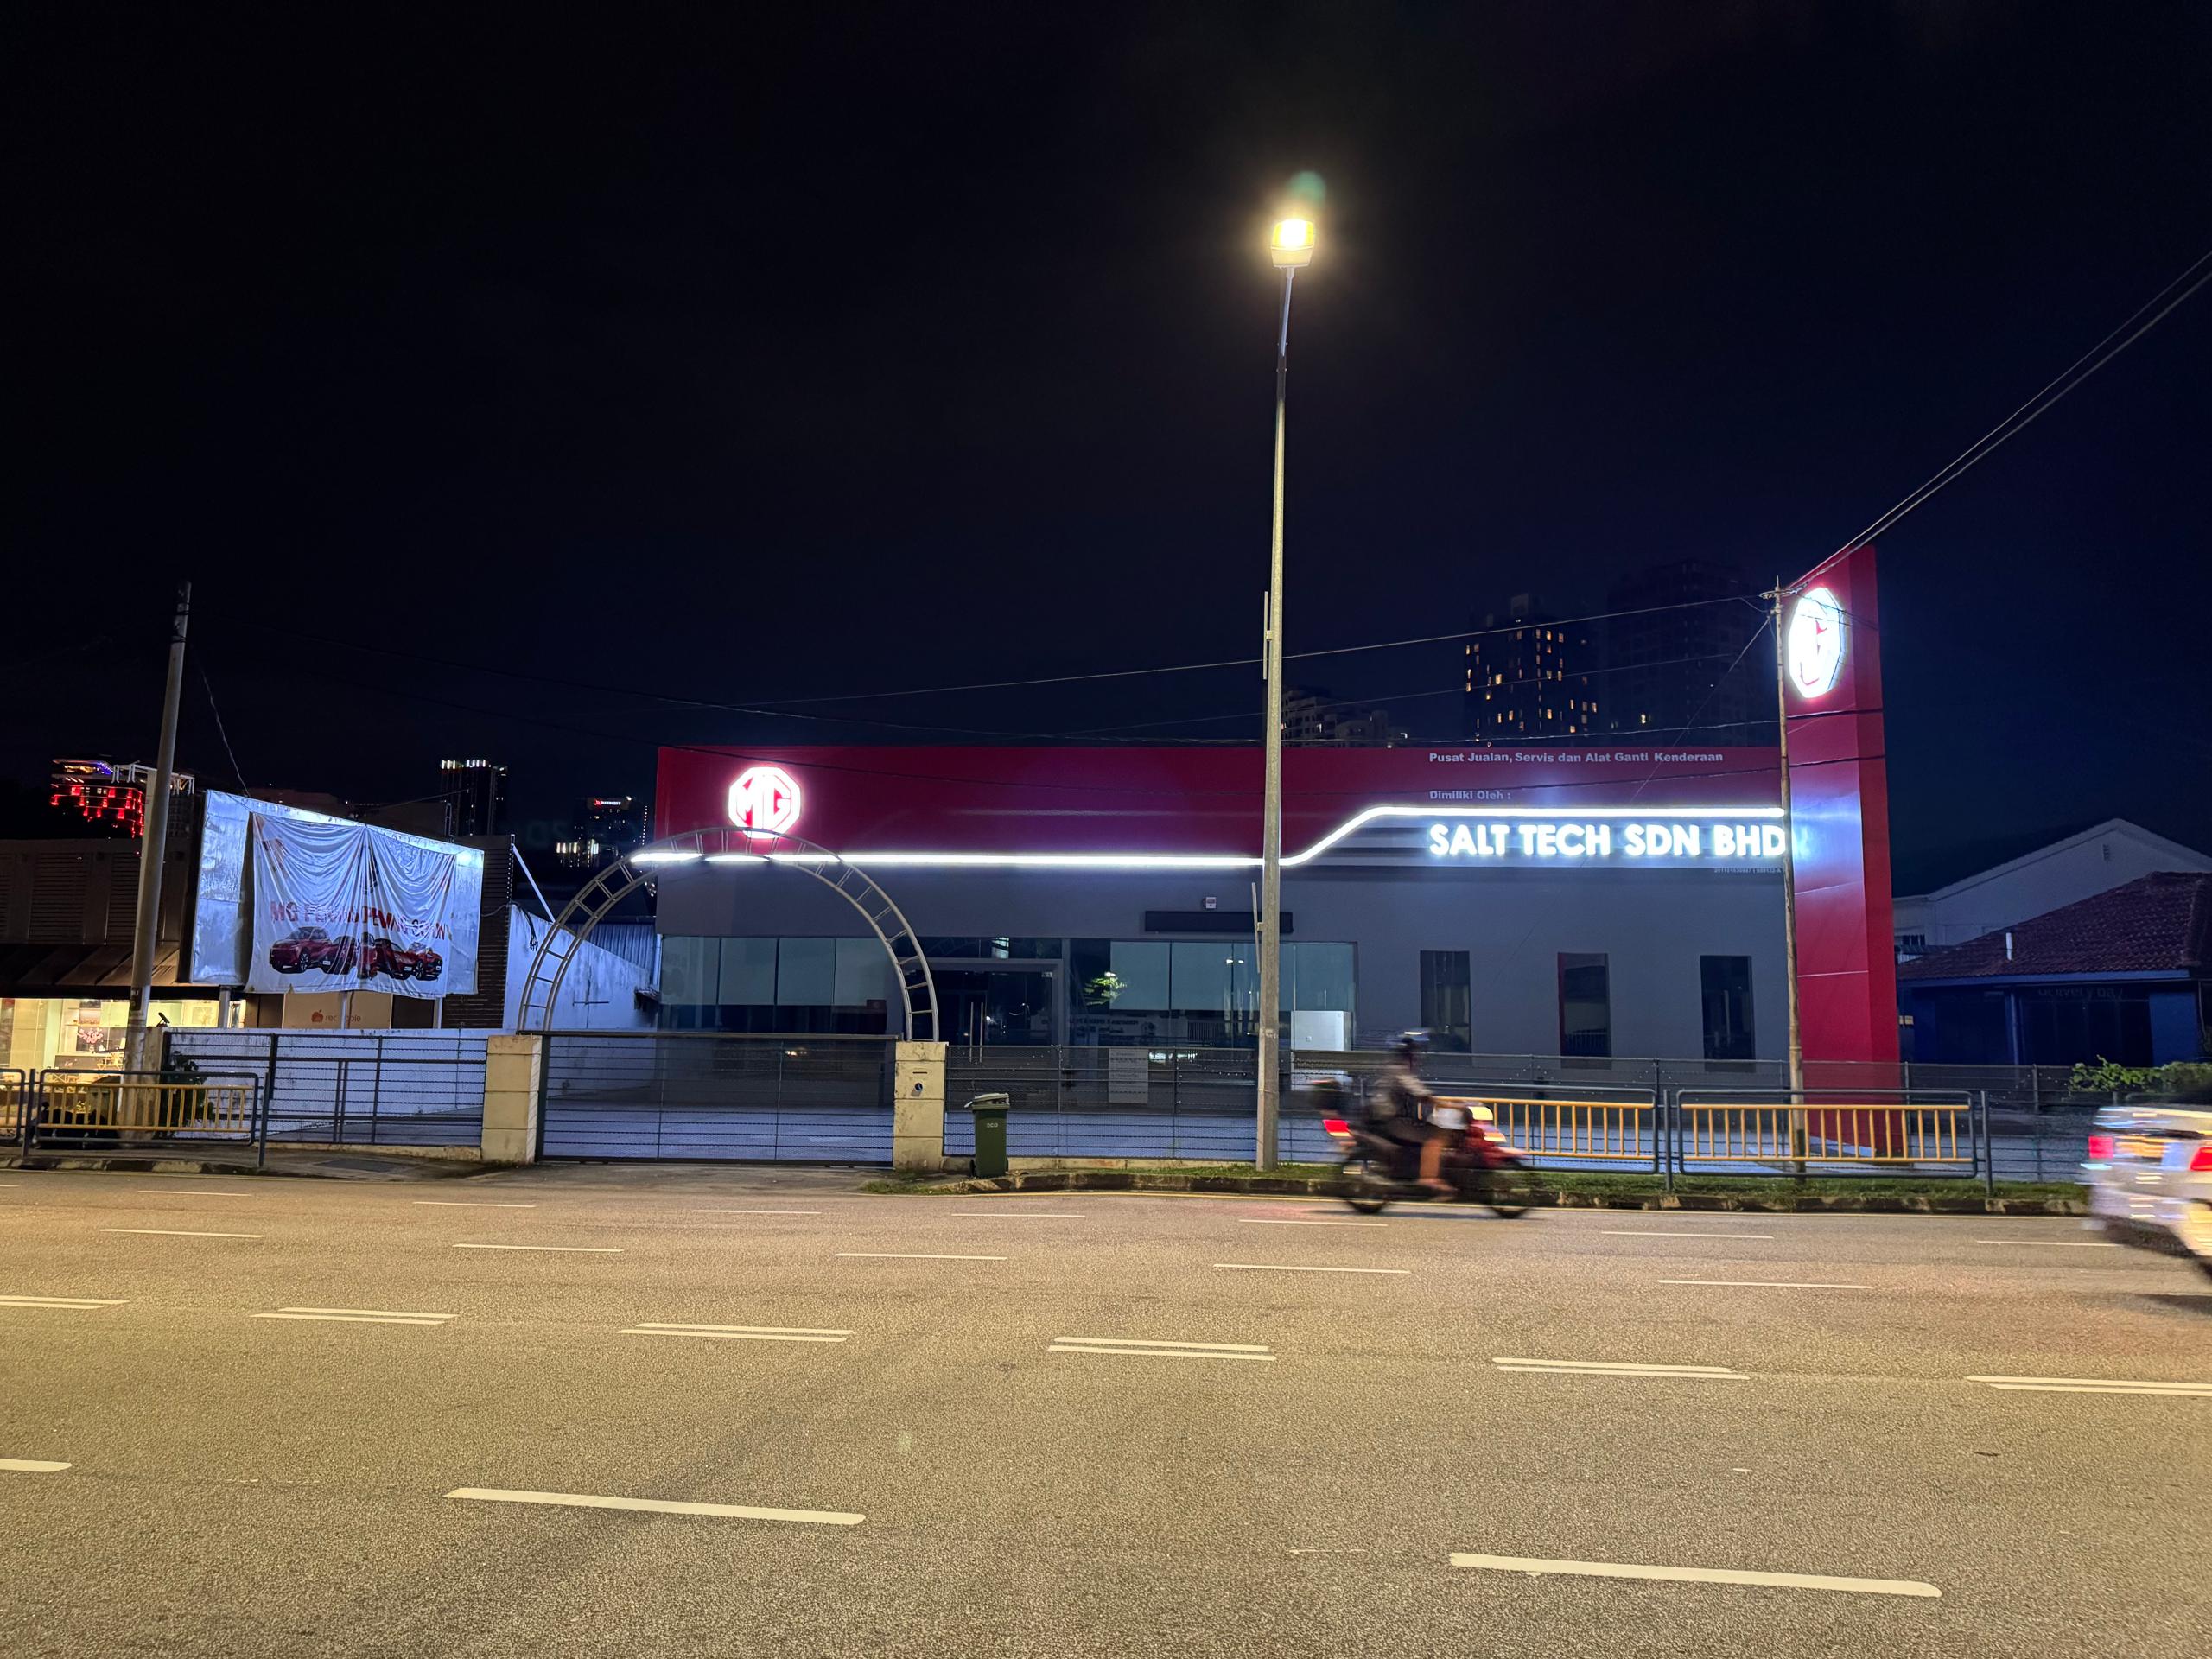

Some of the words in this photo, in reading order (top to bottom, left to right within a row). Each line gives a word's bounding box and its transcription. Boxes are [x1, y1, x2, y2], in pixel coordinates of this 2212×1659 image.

[1429, 753, 1465, 762] Pusat
[1468, 753, 1513, 763] Jualan,
[1515, 753, 1554, 762] Servis
[1558, 753, 1581, 762] dan
[1585, 753, 1611, 762] Alat
[1614, 752, 1649, 762] Ganti
[1654, 753, 1724, 762] Kenderaan
[732, 770, 797, 835] MG
[1429, 790, 1473, 800] Dimiliki
[1477, 790, 1503, 800] Oleh
[1429, 823, 1510, 856] SALT
[1518, 823, 1611, 857] TECH
[1624, 823, 1700, 856] SDN
[1713, 824, 1786, 857] BHD
